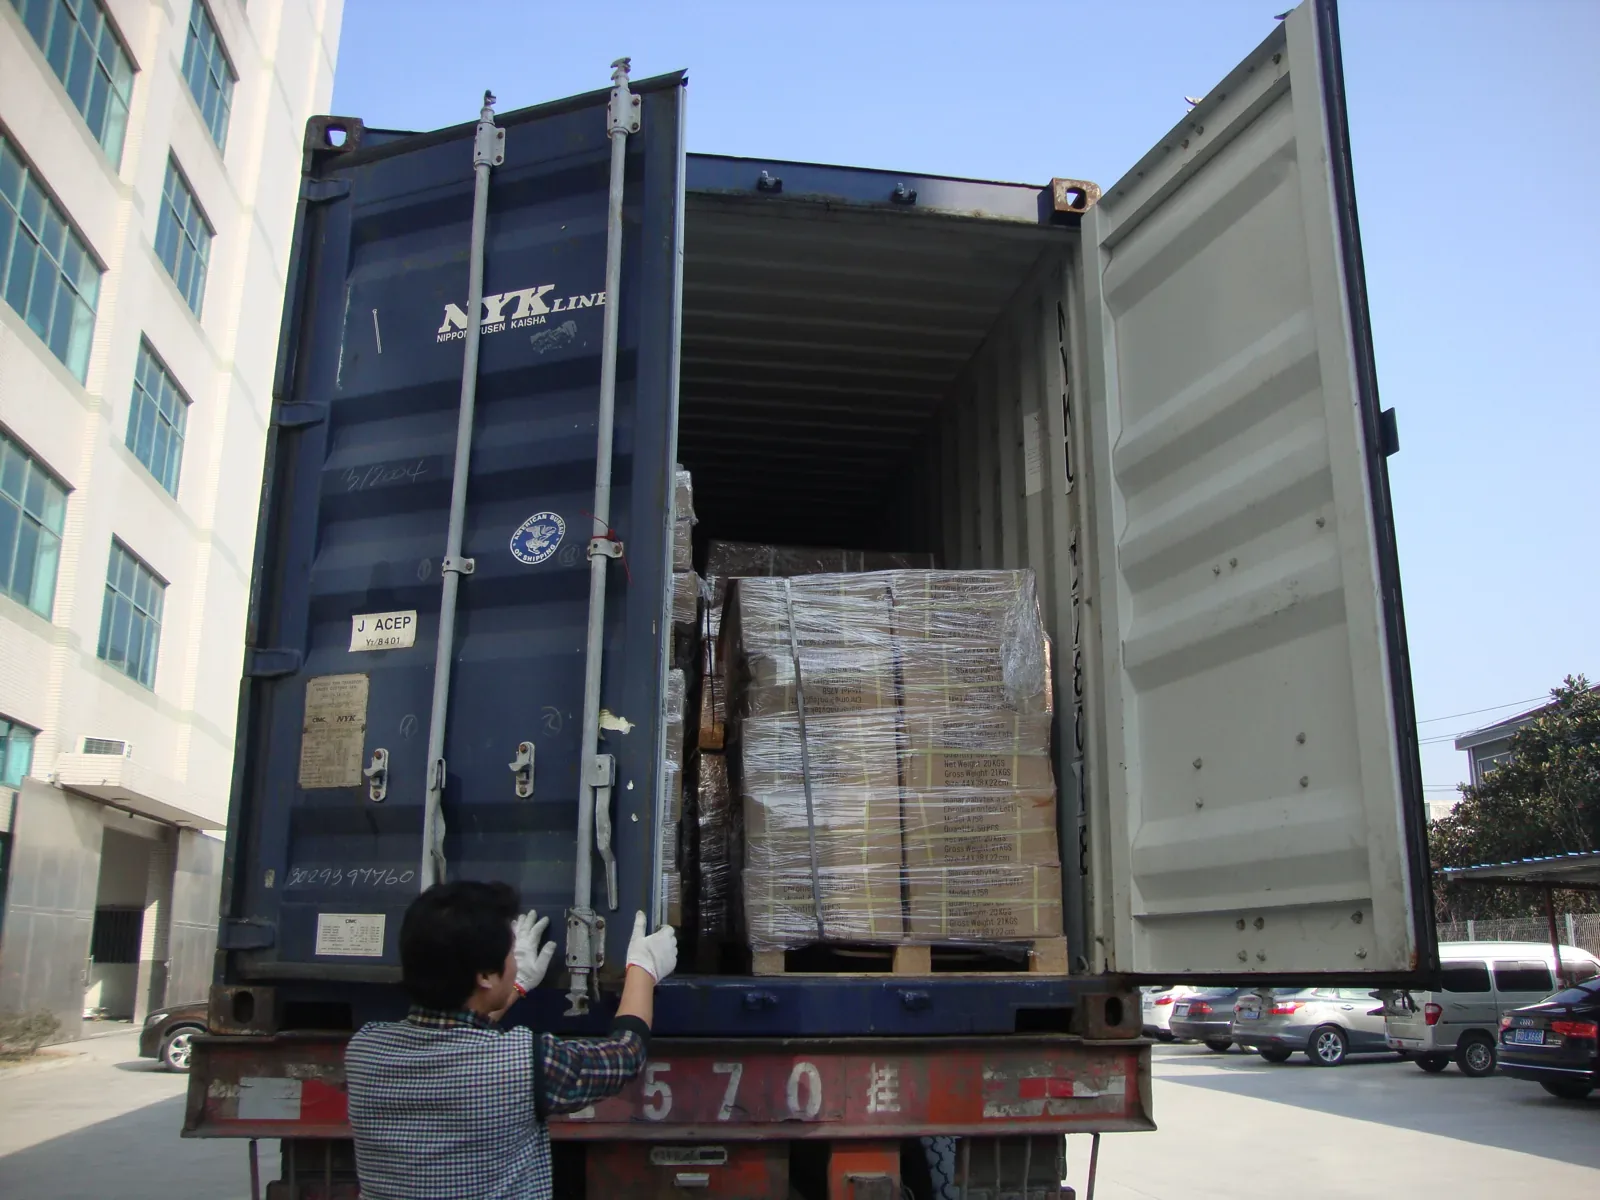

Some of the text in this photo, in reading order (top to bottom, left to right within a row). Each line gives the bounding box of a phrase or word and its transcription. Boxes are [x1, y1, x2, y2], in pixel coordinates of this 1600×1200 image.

[438, 284, 555, 333] NYK
[481, 323, 506, 335] USEN
[511, 315, 546, 329] KAISHA
[514, 514, 564, 540] AMERICAN BUREAU
[514, 544, 556, 562] OF SHIPPING
[357, 616, 412, 632] J ACEP
